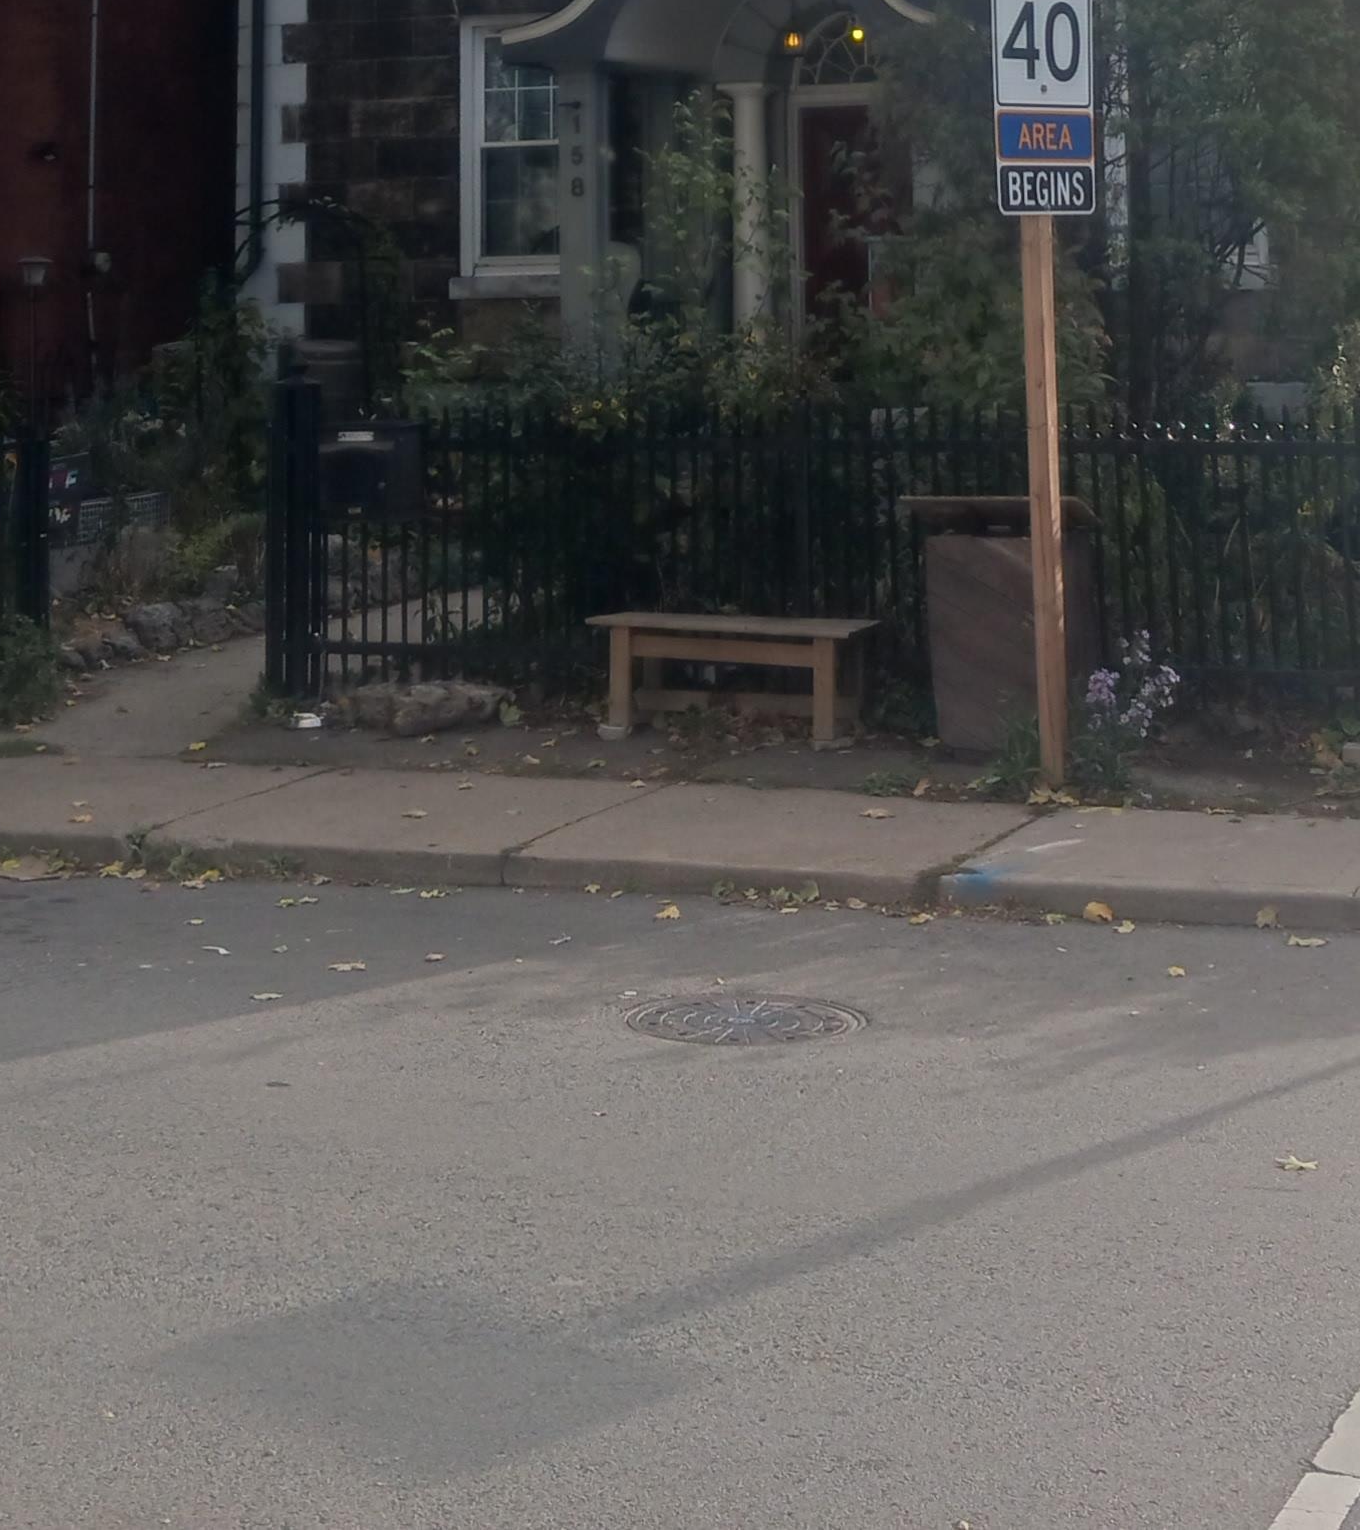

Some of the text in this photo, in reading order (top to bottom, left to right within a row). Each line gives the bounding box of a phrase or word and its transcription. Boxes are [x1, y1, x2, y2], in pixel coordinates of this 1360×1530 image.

[1001, 0, 1081, 82] 40
[571, 114, 585, 198] 158
[1018, 123, 1073, 151] AREA
[1007, 171, 1085, 207] BEGINS
